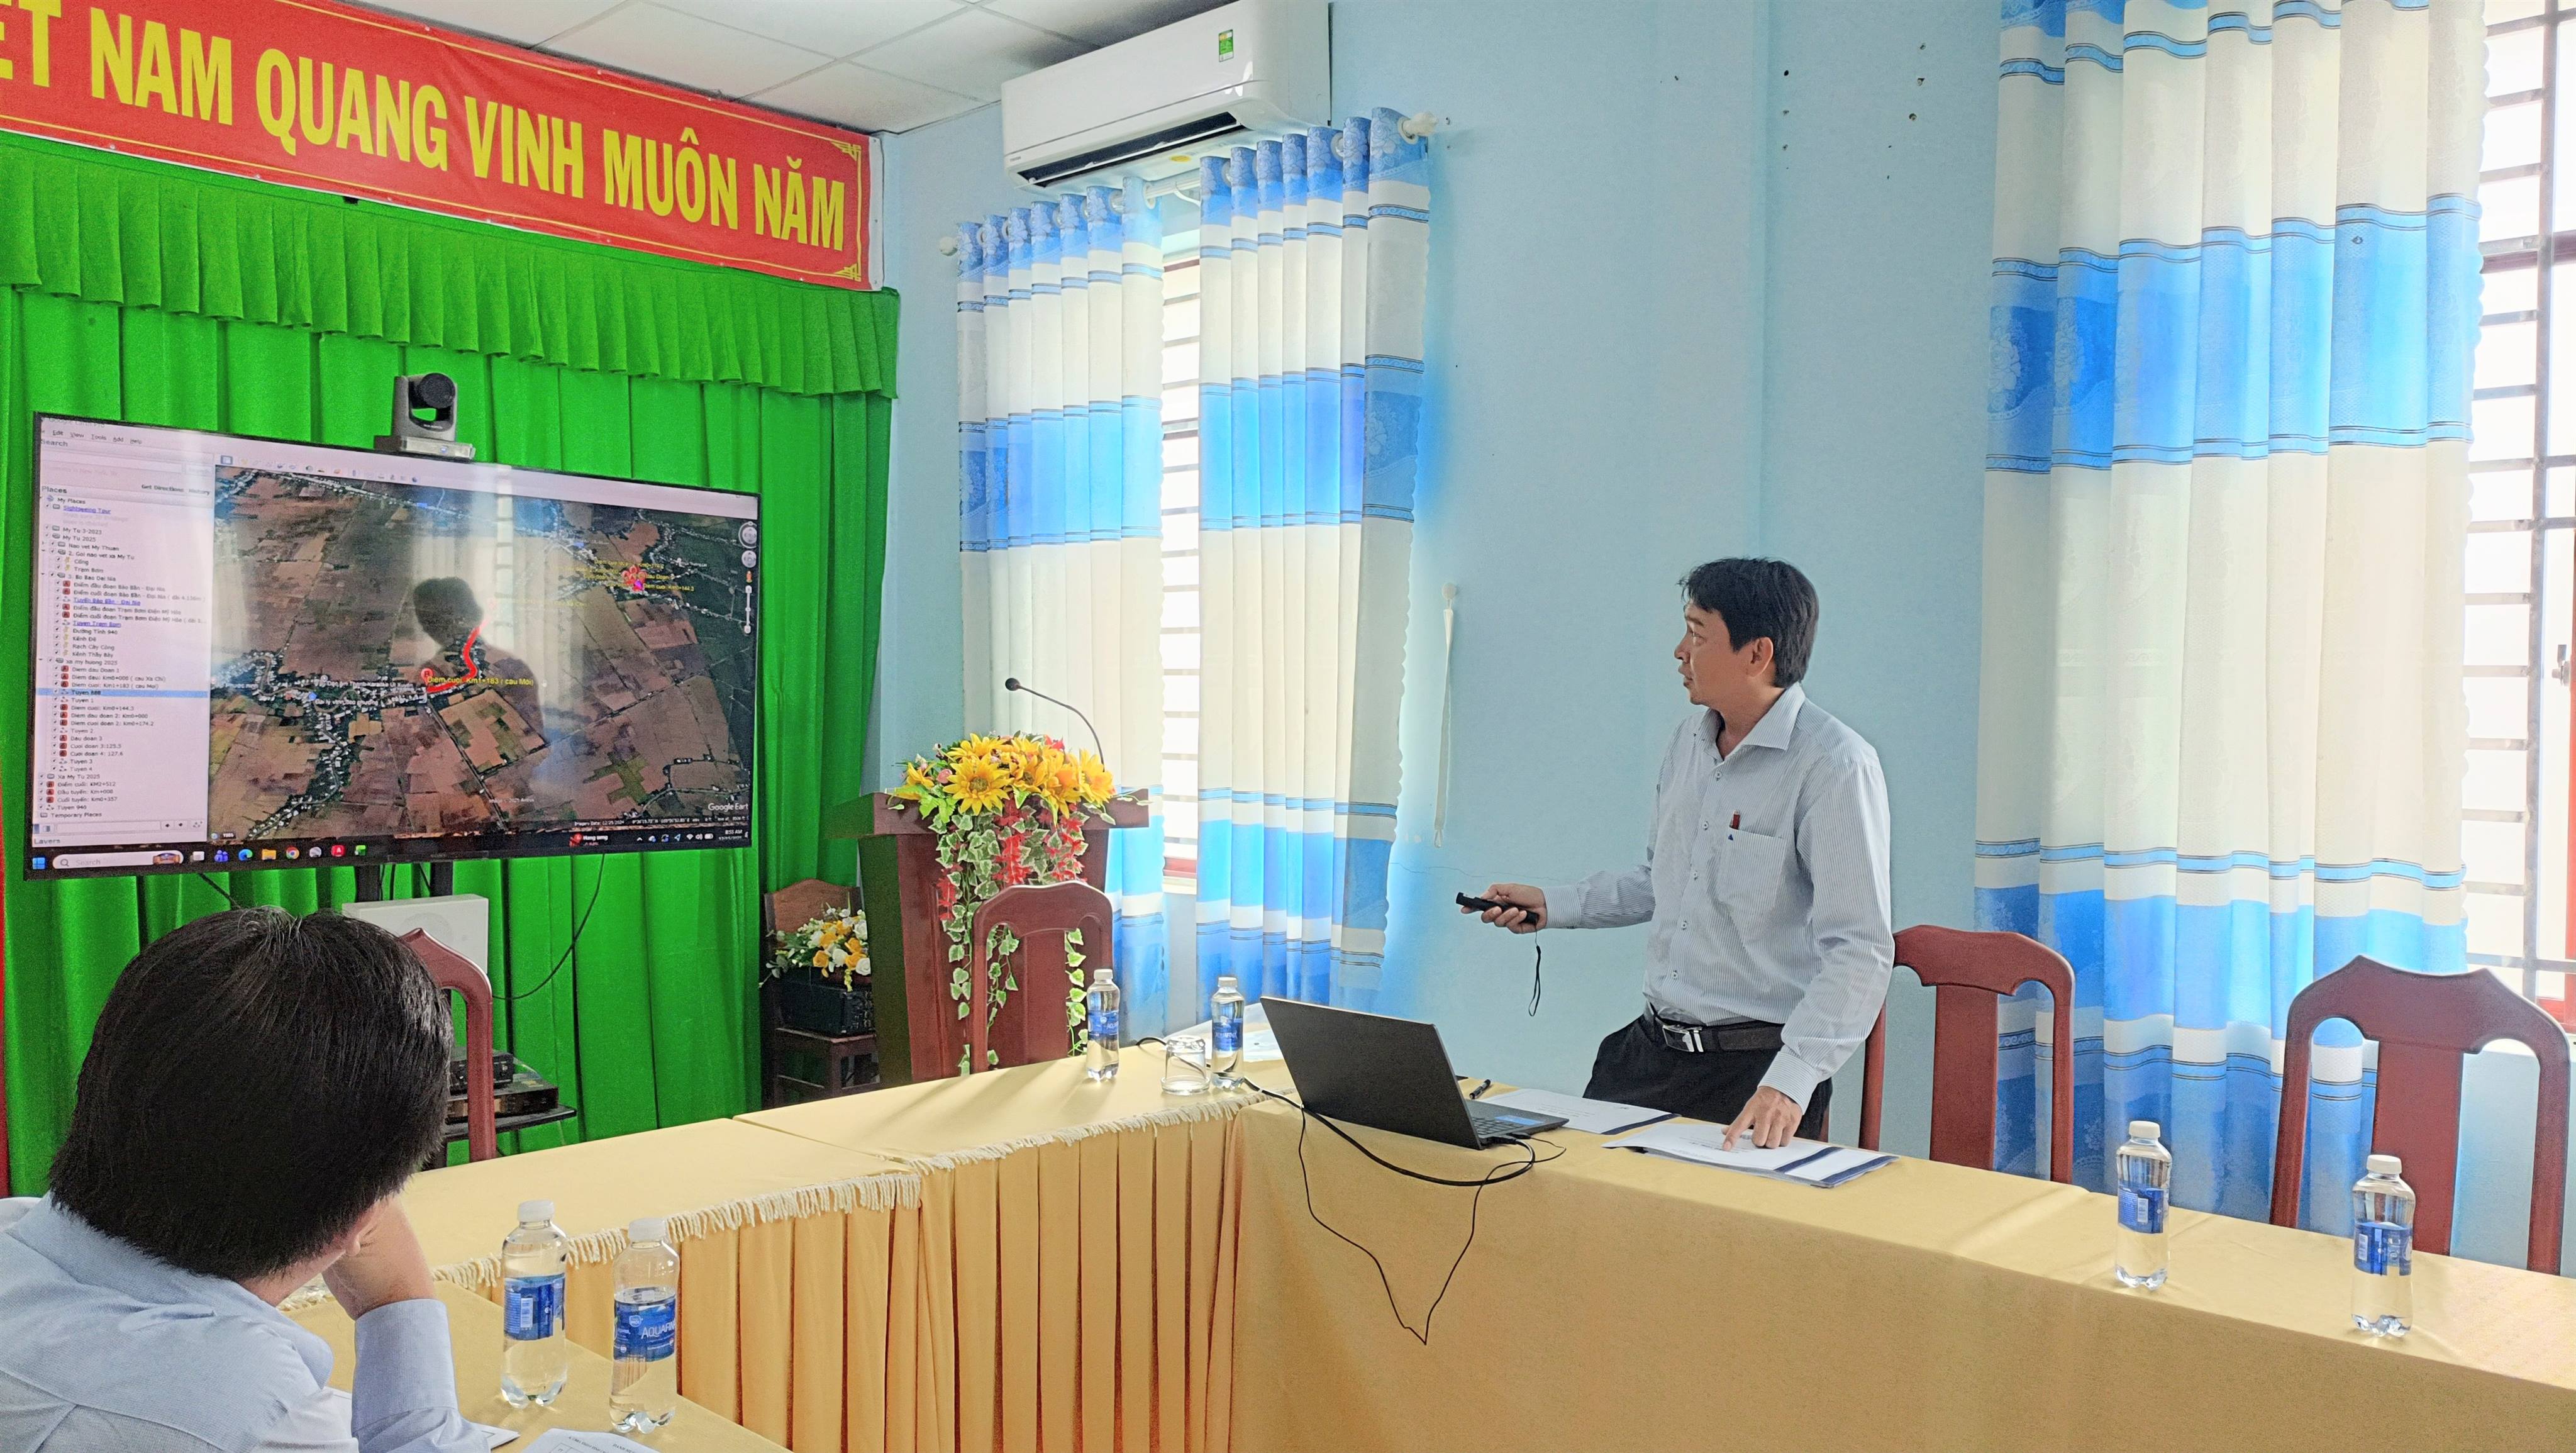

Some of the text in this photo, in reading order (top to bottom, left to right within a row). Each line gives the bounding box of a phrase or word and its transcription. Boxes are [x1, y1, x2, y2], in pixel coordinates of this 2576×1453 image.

[91, 7, 232, 125] NAM
[256, 48, 448, 170] QUANG
[464, 94, 584, 197] VINH
[602, 126, 738, 226] MUÔN
[753, 157, 845, 250] NĂM
[42, 486, 67, 494] Places
[708, 803, 733, 812] Google
